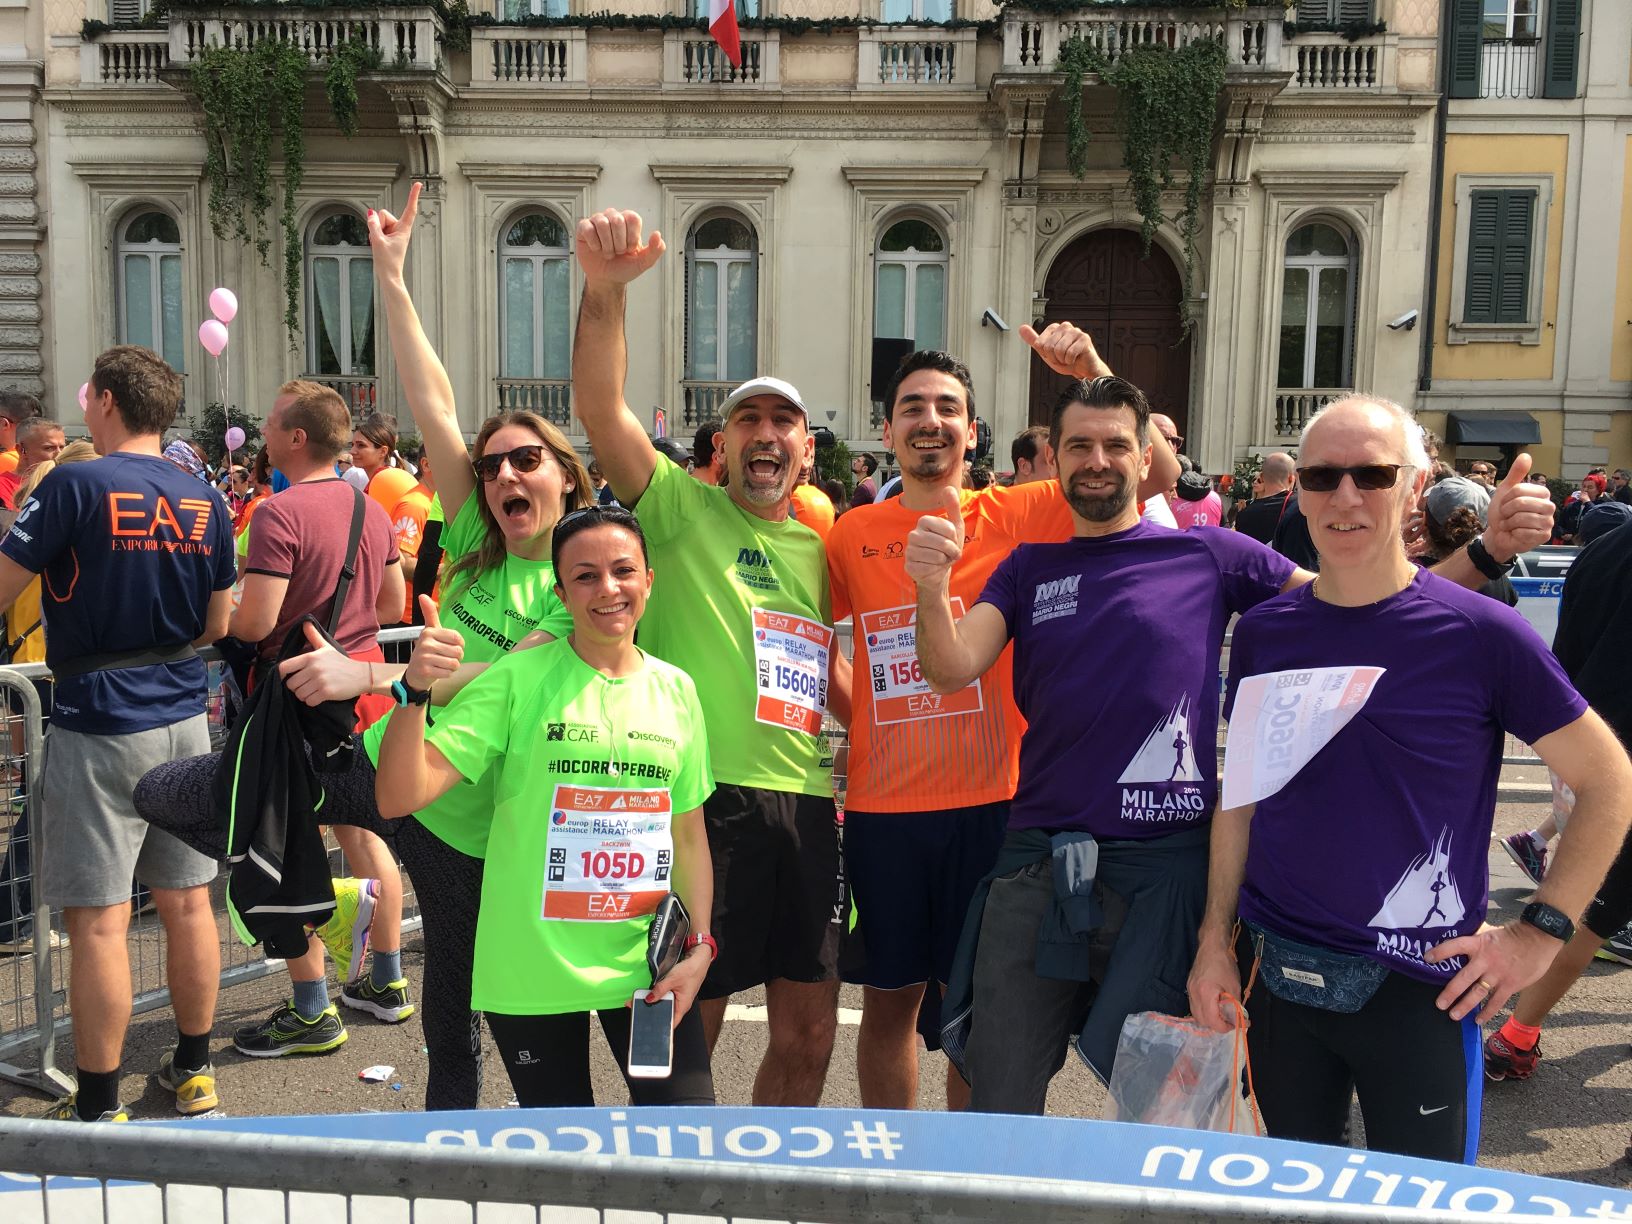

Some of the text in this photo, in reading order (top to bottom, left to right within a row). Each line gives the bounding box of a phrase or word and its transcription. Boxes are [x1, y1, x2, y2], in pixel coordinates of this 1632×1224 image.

[1045, 217, 1052, 228] N
[110, 492, 212, 541] EA7
[1193, 513, 1208, 527] 39
[1032, 606, 1053, 618] MARIO
[1054, 601, 1078, 611] NEGRI
[768, 615, 790, 627] EA7
[878, 613, 901, 627] EA7
[878, 637, 895, 646] europ
[897, 632, 916, 641] REL
[784, 638, 807, 651] RELAY
[869, 644, 896, 653] assistance
[784, 647, 815, 661] MARATHON
[889, 660, 924, 686] 156
[775, 665, 816, 699] 1560B
[907, 694, 942, 712] EA7
[783, 704, 807, 724] EA7
[548, 759, 672, 782] #IOCORROPERBENE
[574, 793, 604, 807] EA7
[629, 795, 660, 804] MILANO
[1122, 788, 1205, 811] MILANO
[551, 826, 588, 834] assistance
[593, 819, 629, 828] RELAY
[593, 827, 643, 836] MARATHON
[581, 851, 645, 879] 105D
[588, 894, 632, 912] EA7
